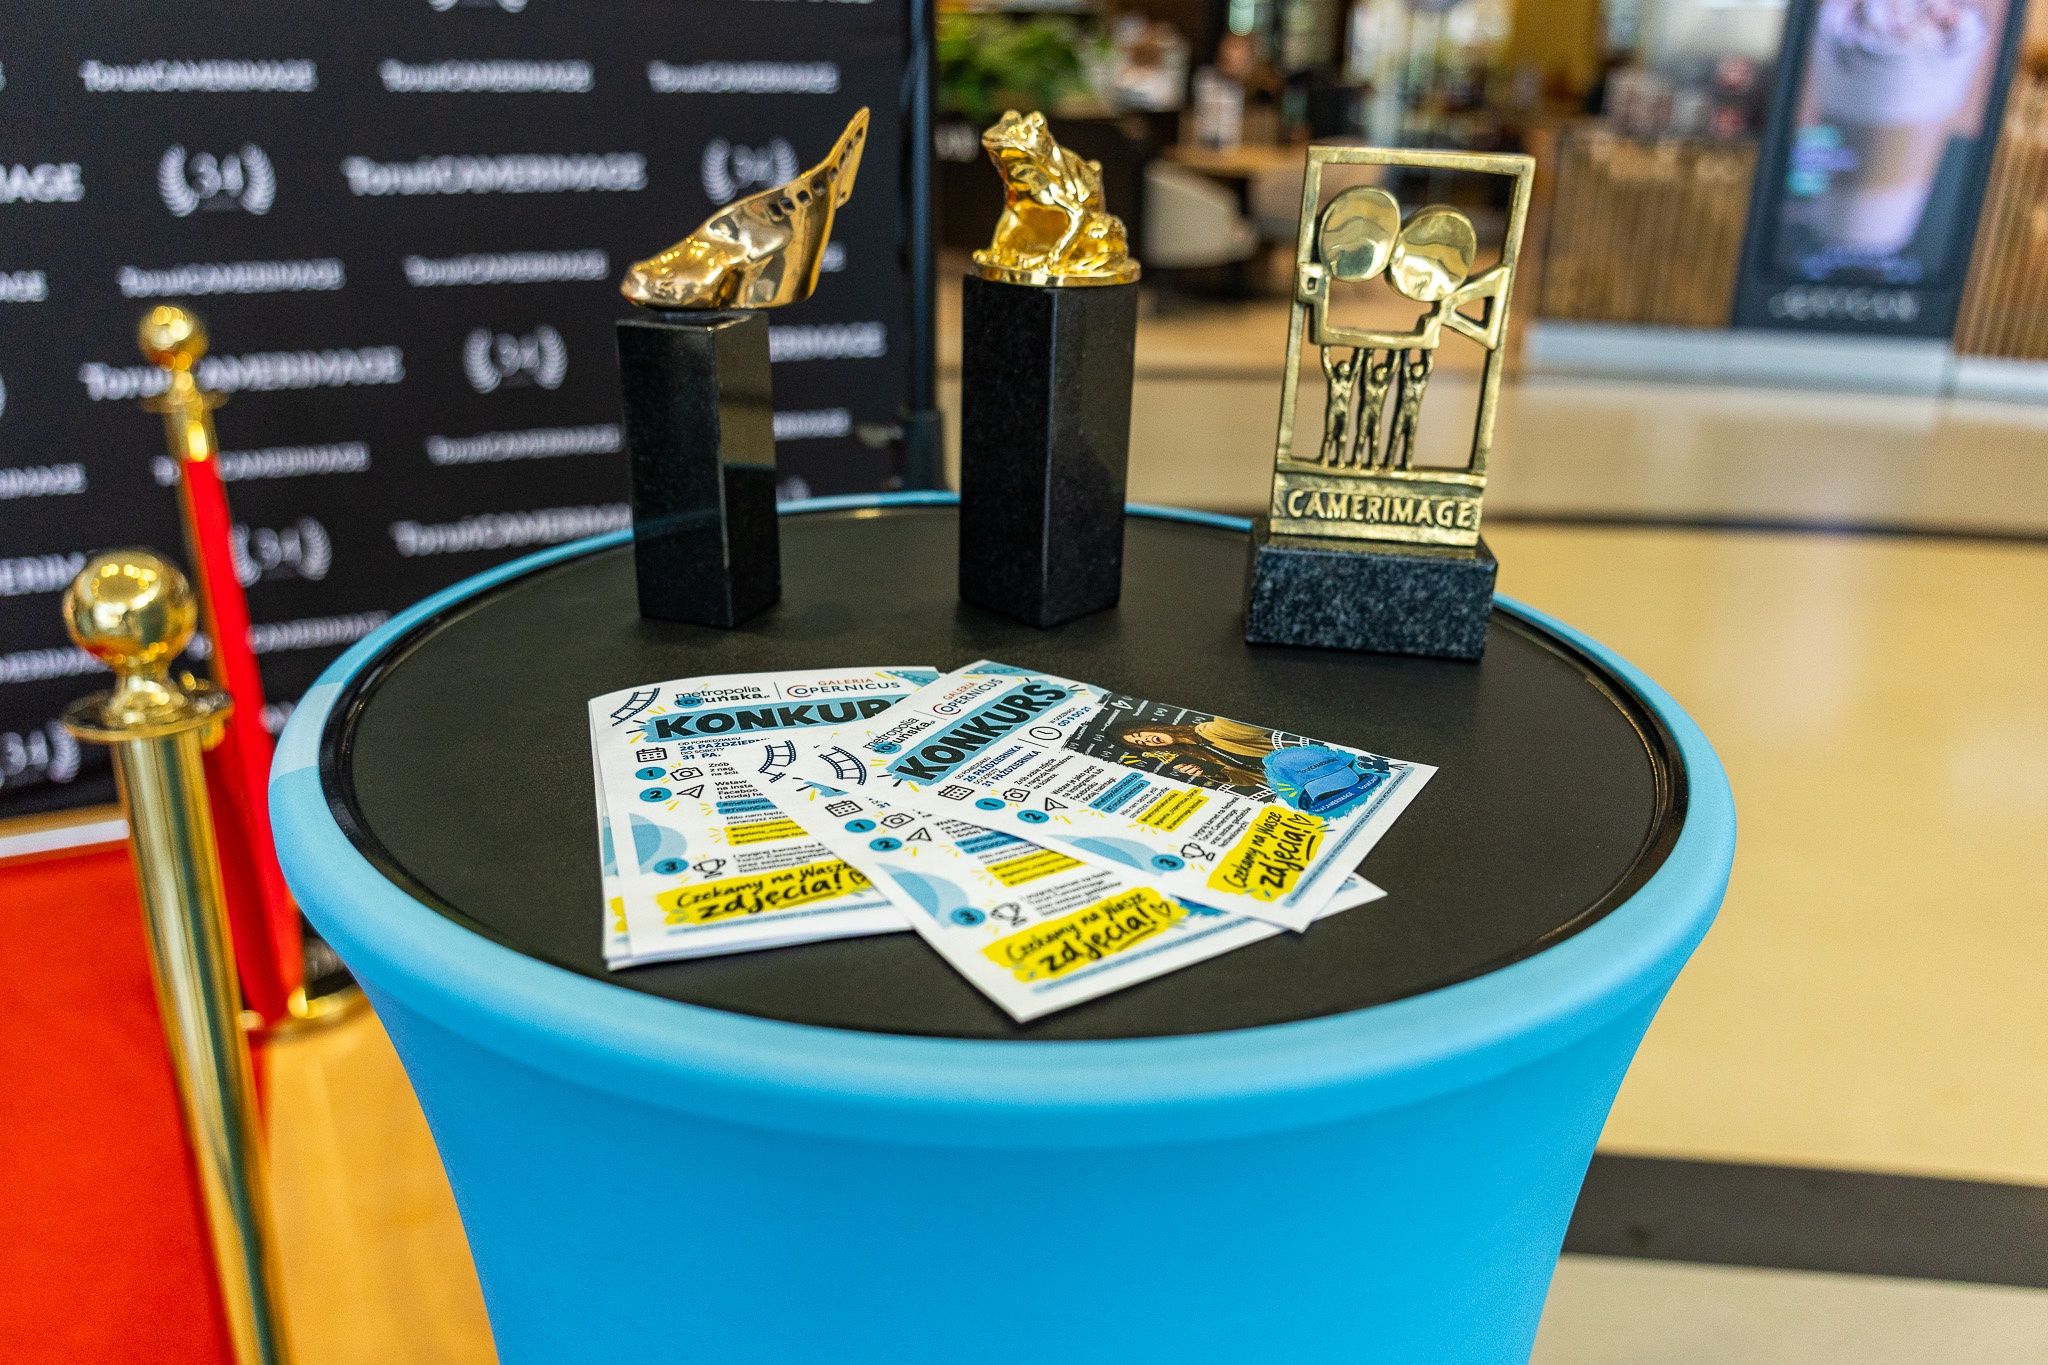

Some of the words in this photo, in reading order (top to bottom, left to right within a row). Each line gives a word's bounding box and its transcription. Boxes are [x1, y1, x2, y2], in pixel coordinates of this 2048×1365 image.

[1287, 490, 1473, 528] CAMERIMAGE
[675, 686, 760, 698] metropolia
[940, 681, 978, 700] GALERIA
[655, 696, 907, 738] KONKUR
[860, 716, 921, 750] metropolia
[890, 682, 1071, 781] KONKURS
[715, 778, 747, 787] Wstaw
[730, 782, 753, 790] Insta
[962, 774, 977, 782] 26
[718, 785, 758, 797] Faceboo
[1255, 811, 1283, 838] Wasze
[1247, 834, 1269, 846] na
[1258, 822, 1312, 888] zdjęcia!
[1224, 847, 1269, 887] Czekamy
[770, 872, 794, 883] na
